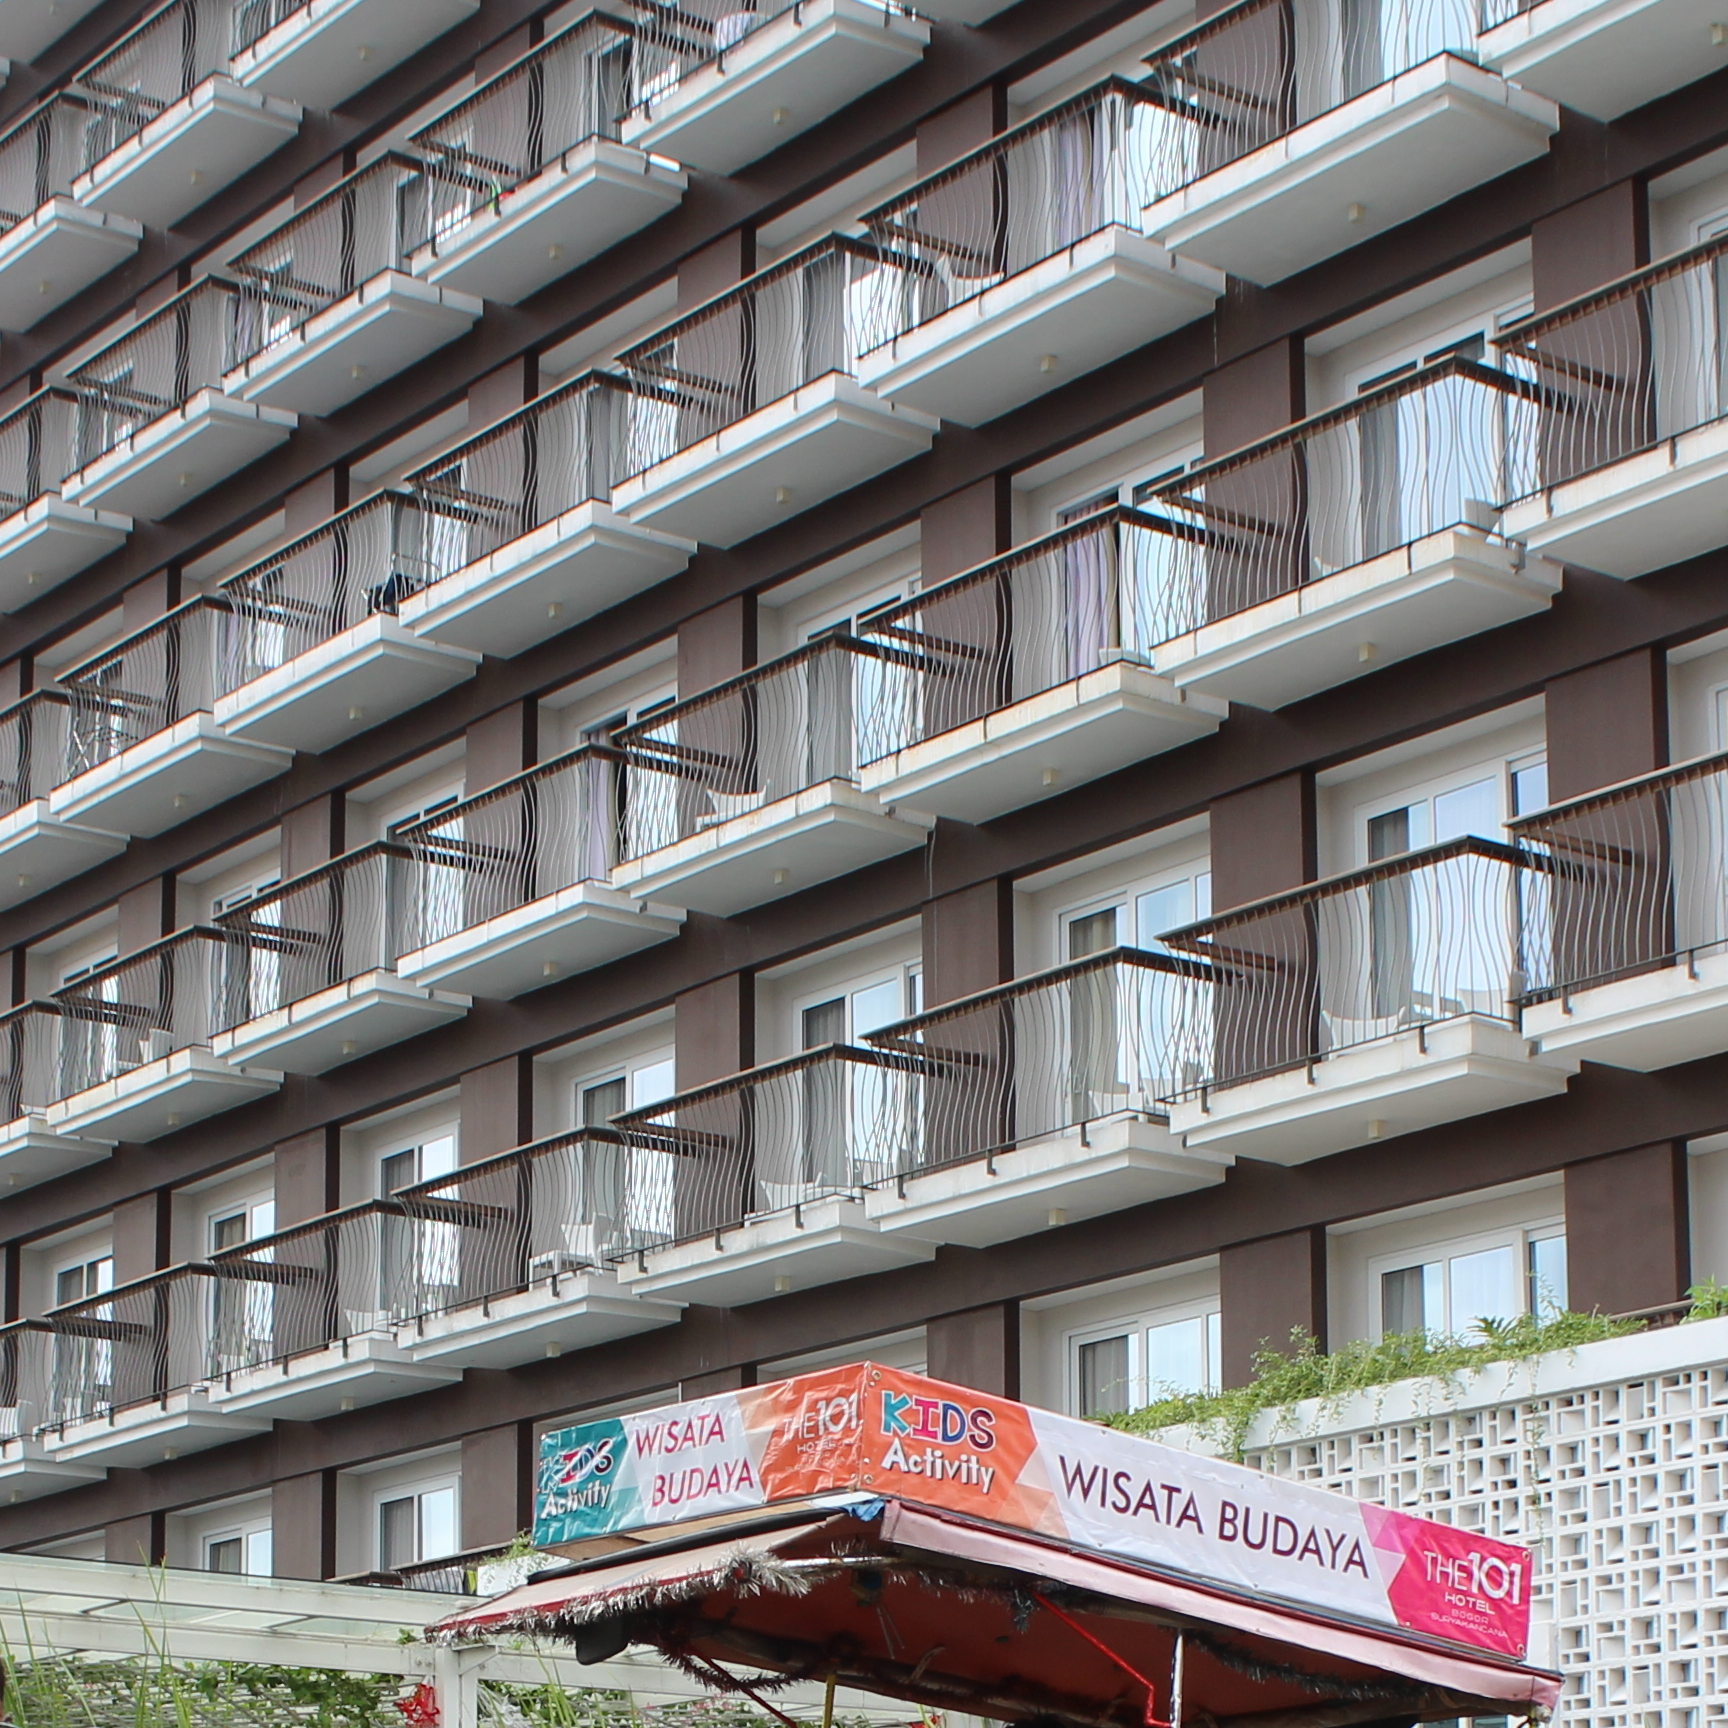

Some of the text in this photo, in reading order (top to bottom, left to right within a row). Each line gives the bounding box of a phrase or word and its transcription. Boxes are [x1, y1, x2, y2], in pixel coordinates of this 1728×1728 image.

[635, 1411, 725, 1461] WISATA
[880, 1390, 997, 1452] KIDS
[650, 1457, 756, 1508] BUDAYA
[881, 1438, 995, 1494] Activity
[540, 1482, 612, 1519] Activity
[1058, 1454, 1371, 1579] WISATA BUDAYA
[1445, 1591, 1496, 1615] HOTEL
[1451, 1609, 1490, 1625] BOGOR
